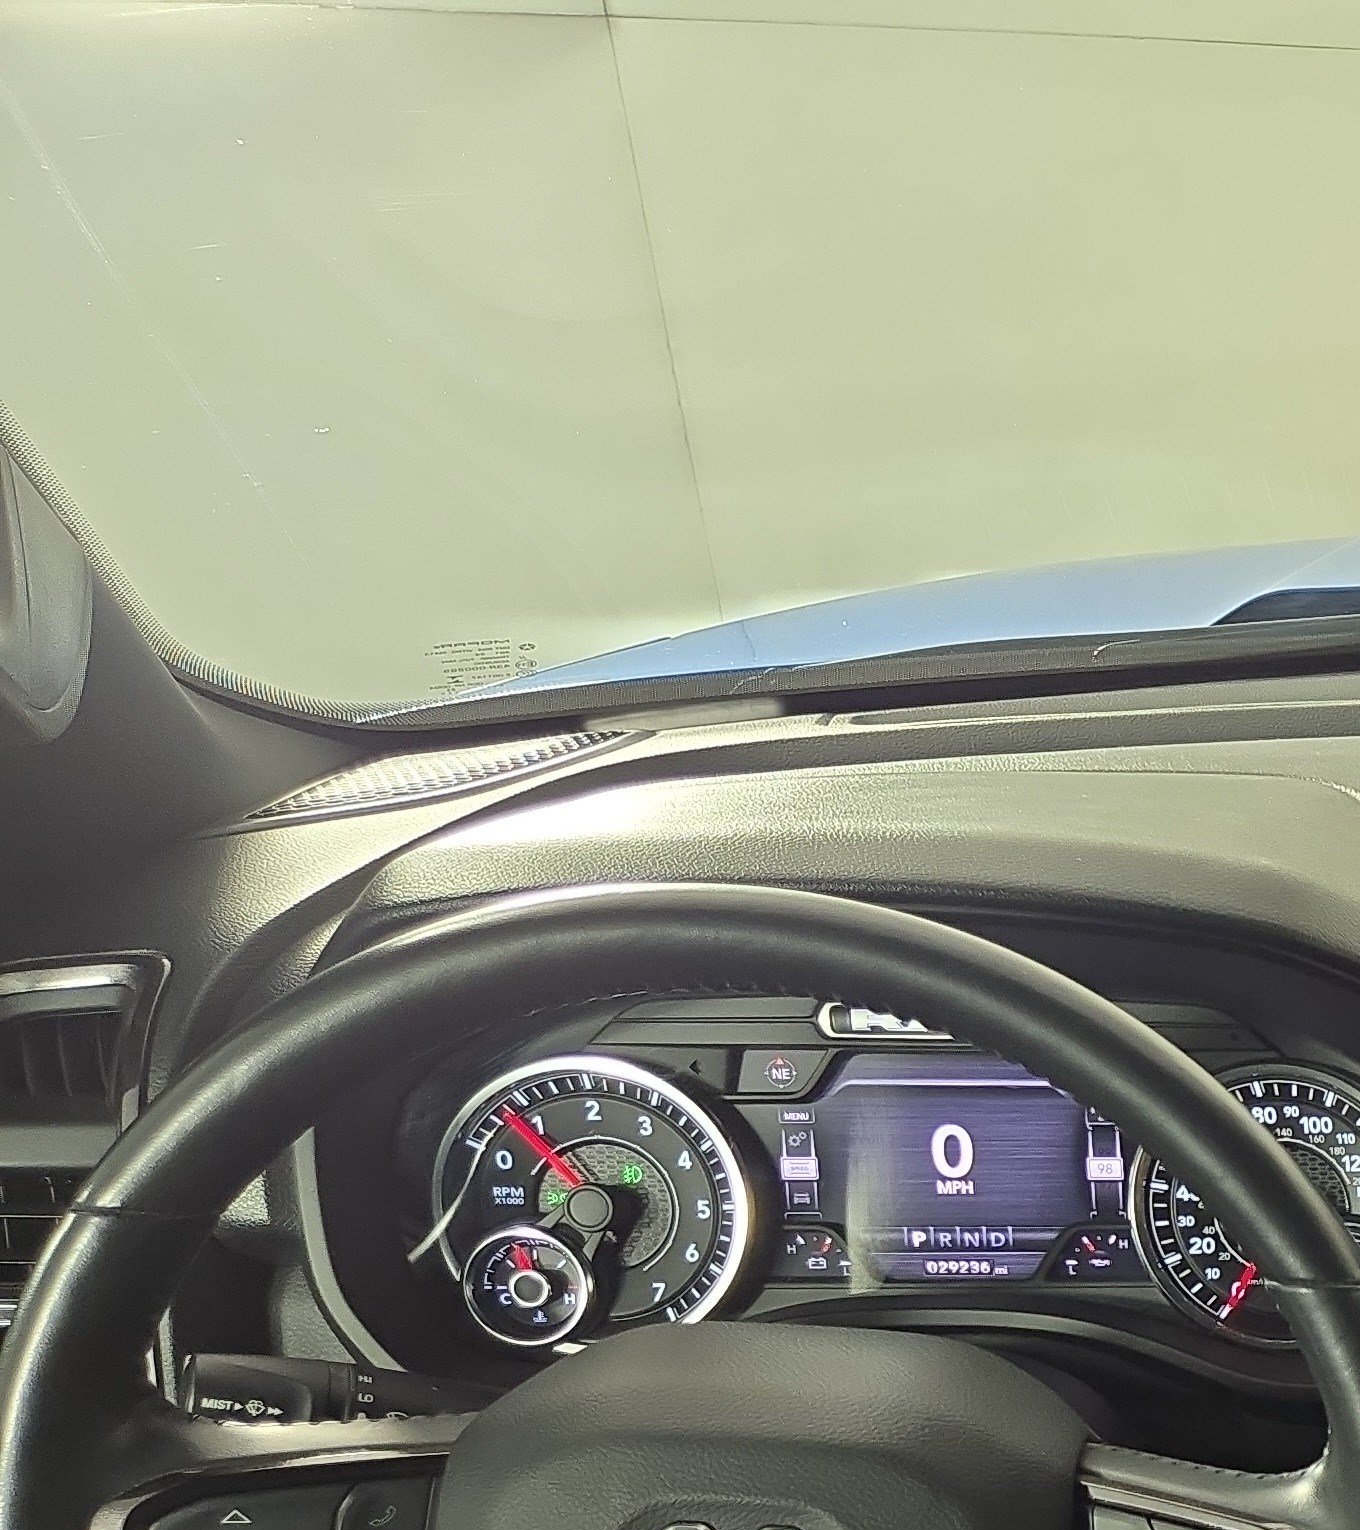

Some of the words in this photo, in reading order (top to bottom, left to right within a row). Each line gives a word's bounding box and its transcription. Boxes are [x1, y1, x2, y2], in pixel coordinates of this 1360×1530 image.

[771, 1067, 791, 1080] NE
[585, 1100, 602, 1121] 2
[1283, 1105, 1299, 1118] 90
[531, 1115, 545, 1136] 1
[637, 1115, 653, 1136] 3
[1299, 1116, 1333, 1135] 100
[1308, 1134, 1325, 1144] 160
[1335, 1133, 1356, 1145] 110
[930, 1123, 974, 1179] 0
[496, 1150, 513, 1171] 0
[677, 1150, 692, 1171] 4
[1096, 1163, 1113, 1175] 98
[492, 1186, 525, 1198] RPM
[936, 1180, 975, 1196] MPH
[696, 1200, 711, 1220] 5
[1177, 1215, 1196, 1228] 30
[1202, 1226, 1216, 1235] 40
[911, 1230, 927, 1248] P
[940, 1231, 953, 1248] R
[962, 1231, 980, 1248] N
[990, 1231, 1006, 1248] D
[1118, 1238, 1129, 1249] H
[1188, 1237, 1216, 1255] 20
[685, 1243, 699, 1263] 6
[787, 1244, 797, 1254] H
[1218, 1252, 1231, 1262] 20
[1204, 1267, 1221, 1281] 10
[499, 1292, 513, 1305] C
[564, 1292, 576, 1305] H
[652, 1282, 666, 1303] 7
[200, 1397, 235, 1411] MIST
[357, 1392, 374, 1403] LO
